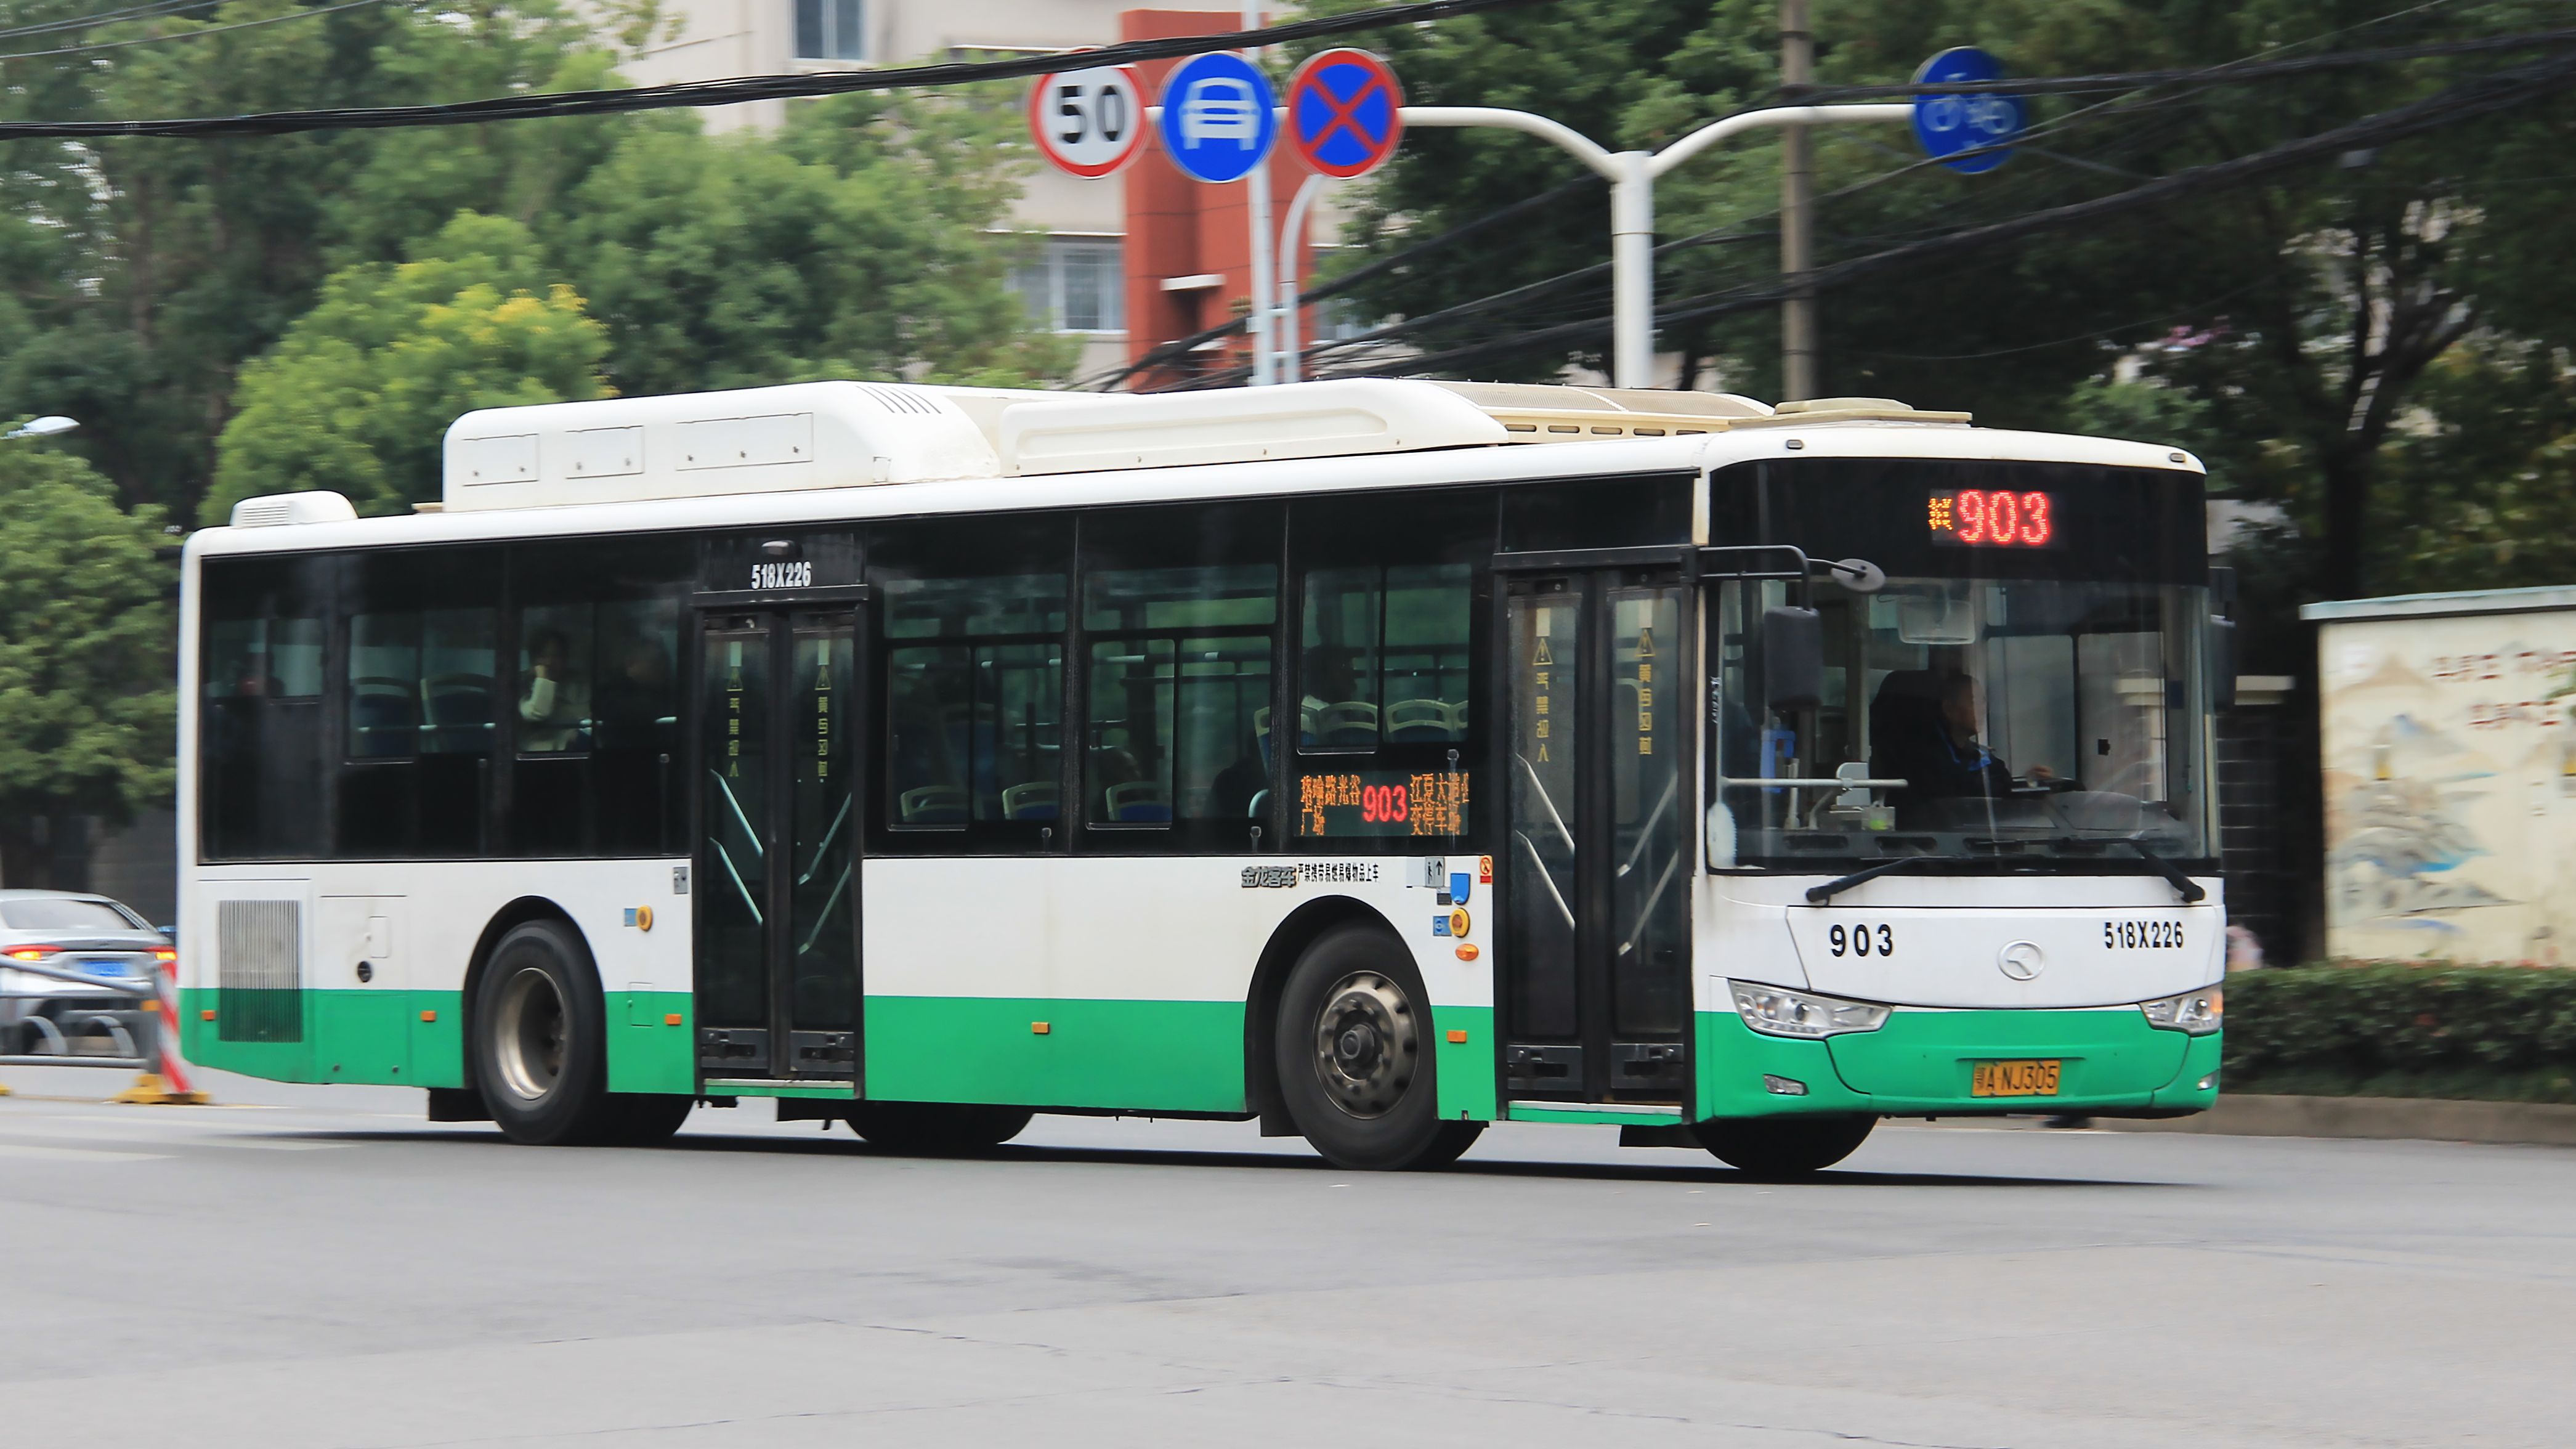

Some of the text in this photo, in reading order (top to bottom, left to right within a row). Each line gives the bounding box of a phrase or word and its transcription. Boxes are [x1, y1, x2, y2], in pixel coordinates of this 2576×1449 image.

[1057, 84, 1125, 145] 50
[1958, 490, 2050, 545] 903
[751, 561, 812, 589] 518X226
[1363, 784, 1408, 822] 903
[1241, 866, 1297, 888] 金龙客车
[1830, 924, 1894, 957] 903
[2104, 921, 2183, 949] 518X226
